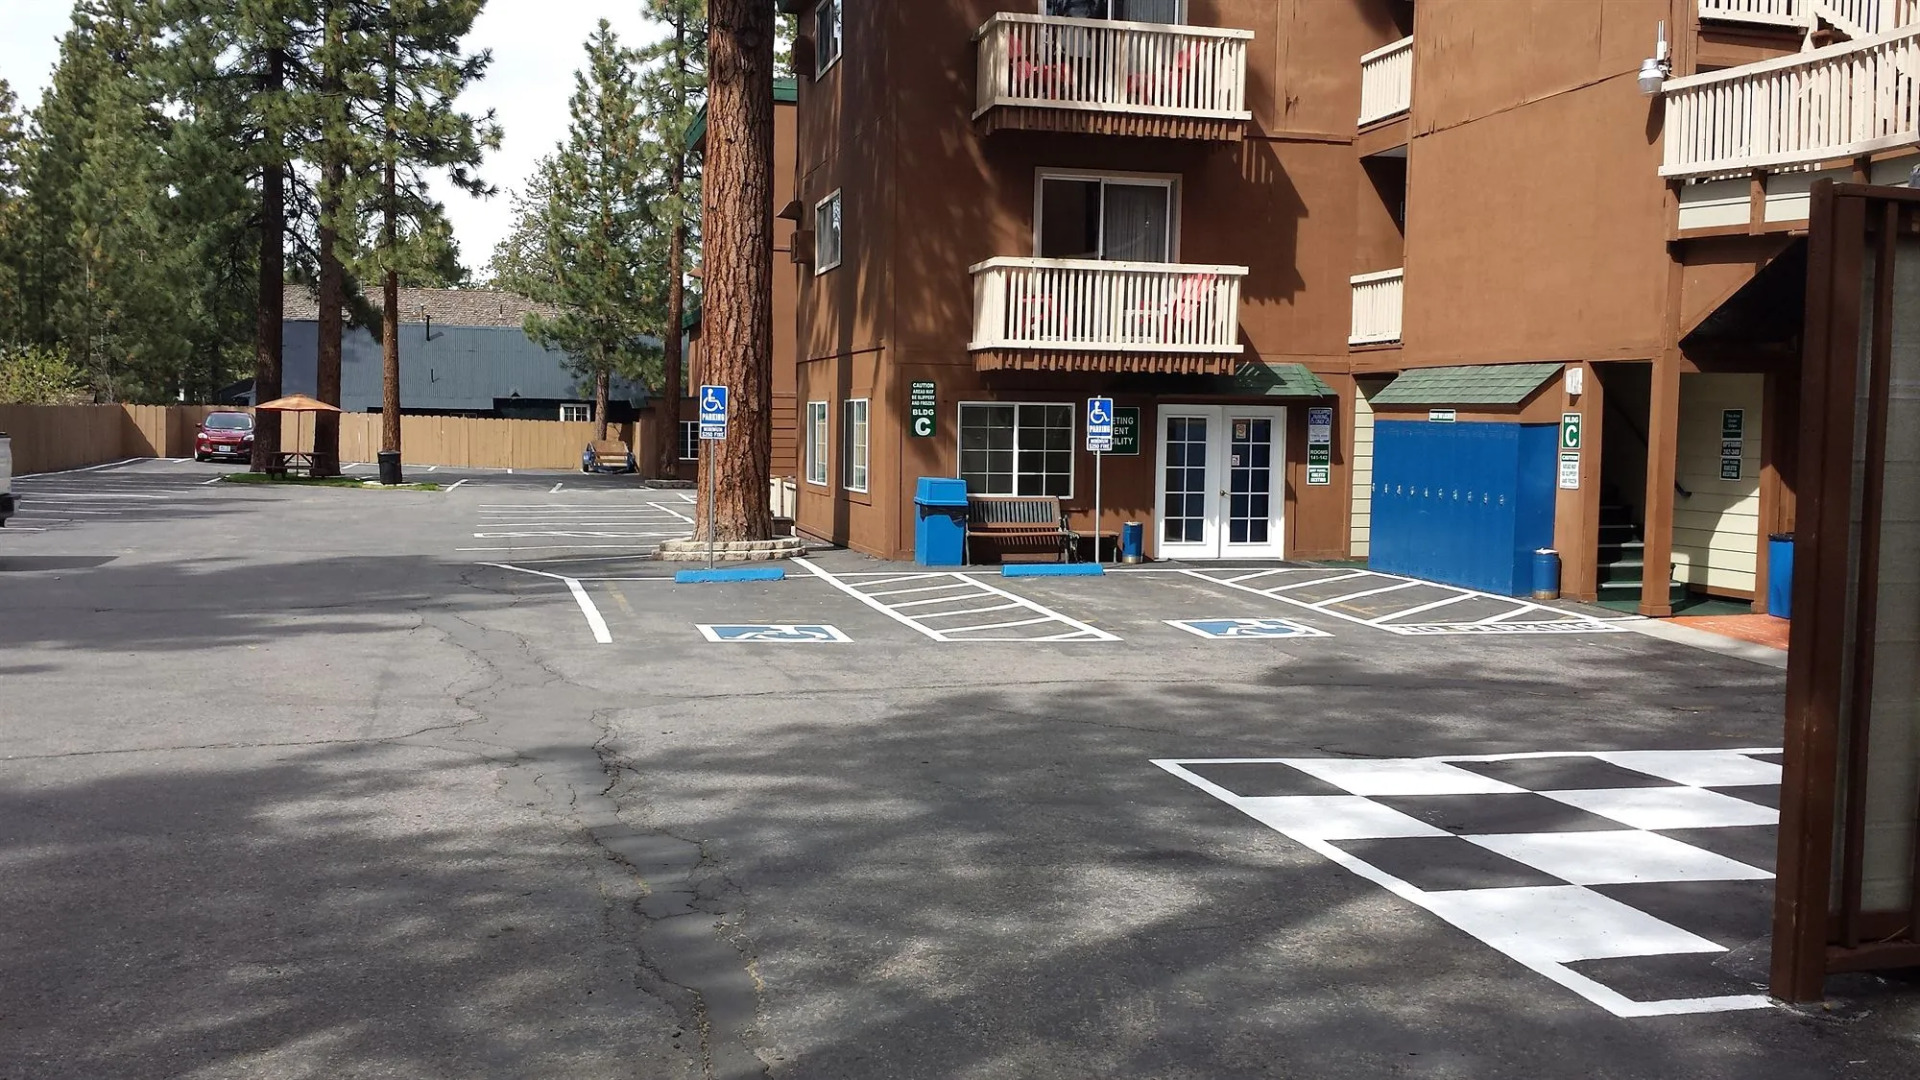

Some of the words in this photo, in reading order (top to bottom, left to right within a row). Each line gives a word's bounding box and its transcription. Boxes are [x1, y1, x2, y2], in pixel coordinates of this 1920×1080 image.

[702, 413, 725, 421] PARKING
[1112, 417, 1134, 425] ETING
[915, 417, 931, 436] C
[1565, 425, 1577, 446] C
[1448, 622, 1603, 632] PARKING
